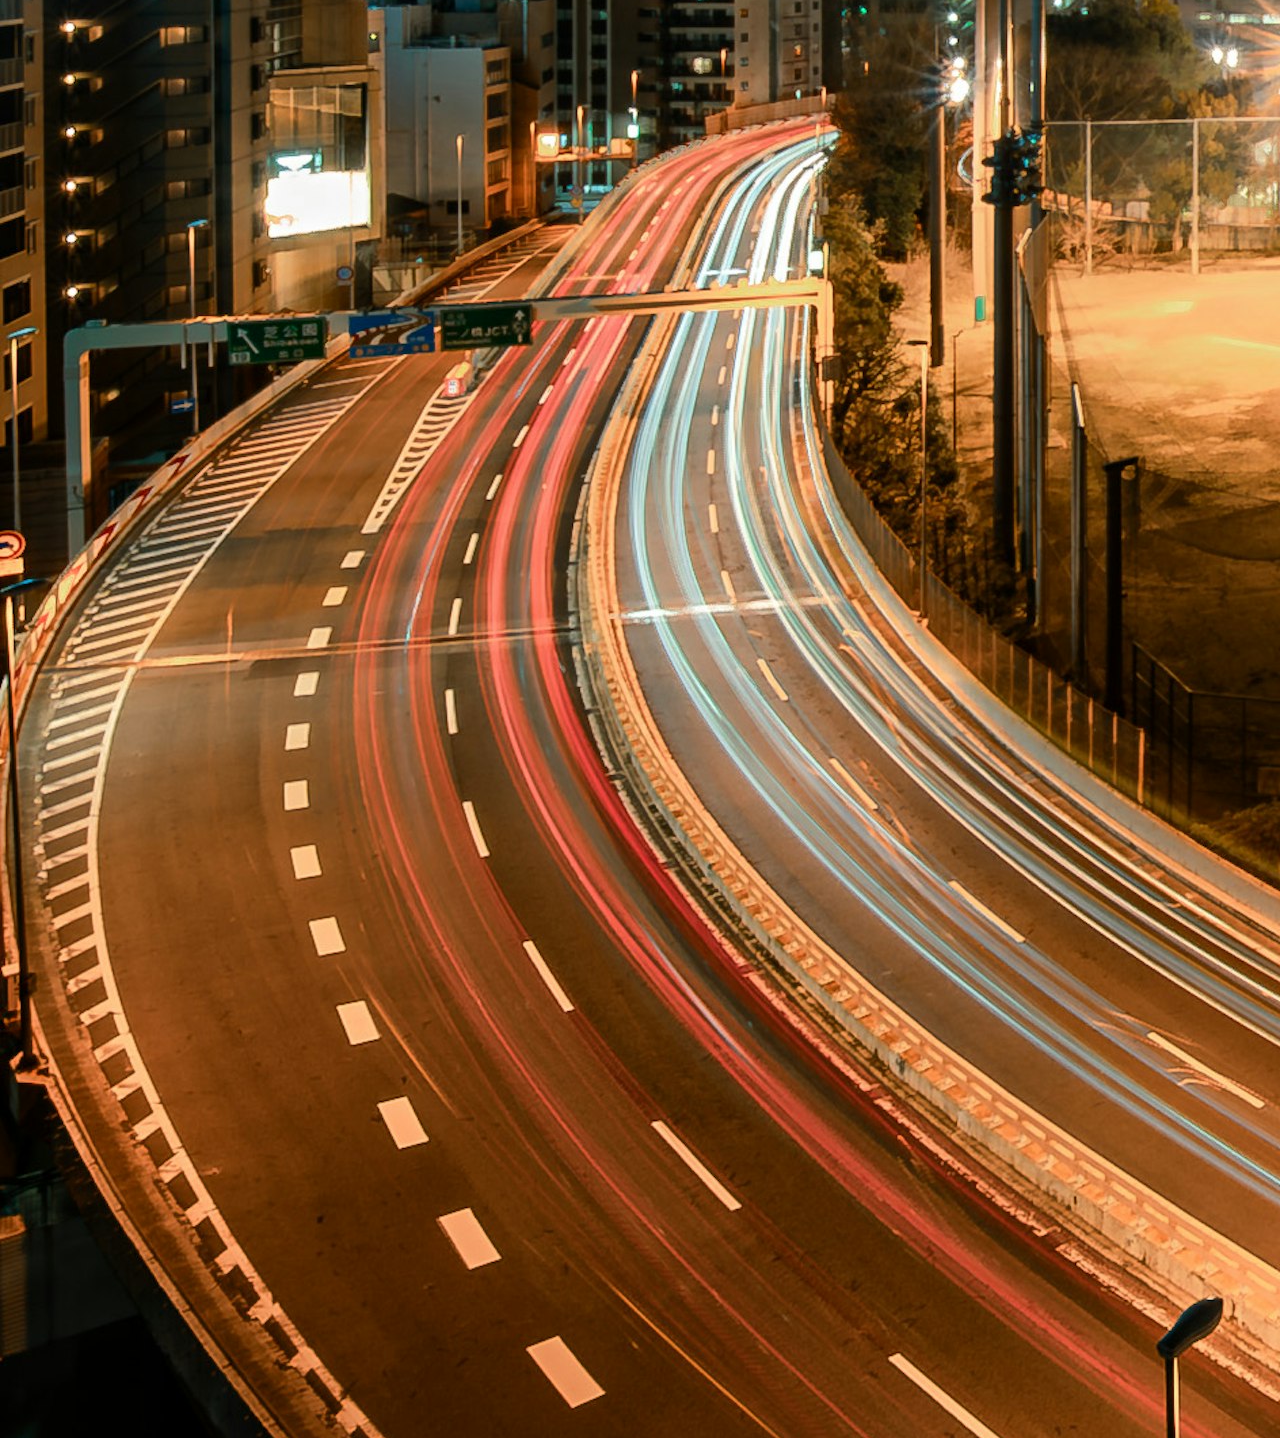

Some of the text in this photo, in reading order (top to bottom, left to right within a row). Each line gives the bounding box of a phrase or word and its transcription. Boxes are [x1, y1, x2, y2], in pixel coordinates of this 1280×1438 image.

[263, 323, 318, 339] 芝公園
[263, 339, 319, 348] Shibakoen
